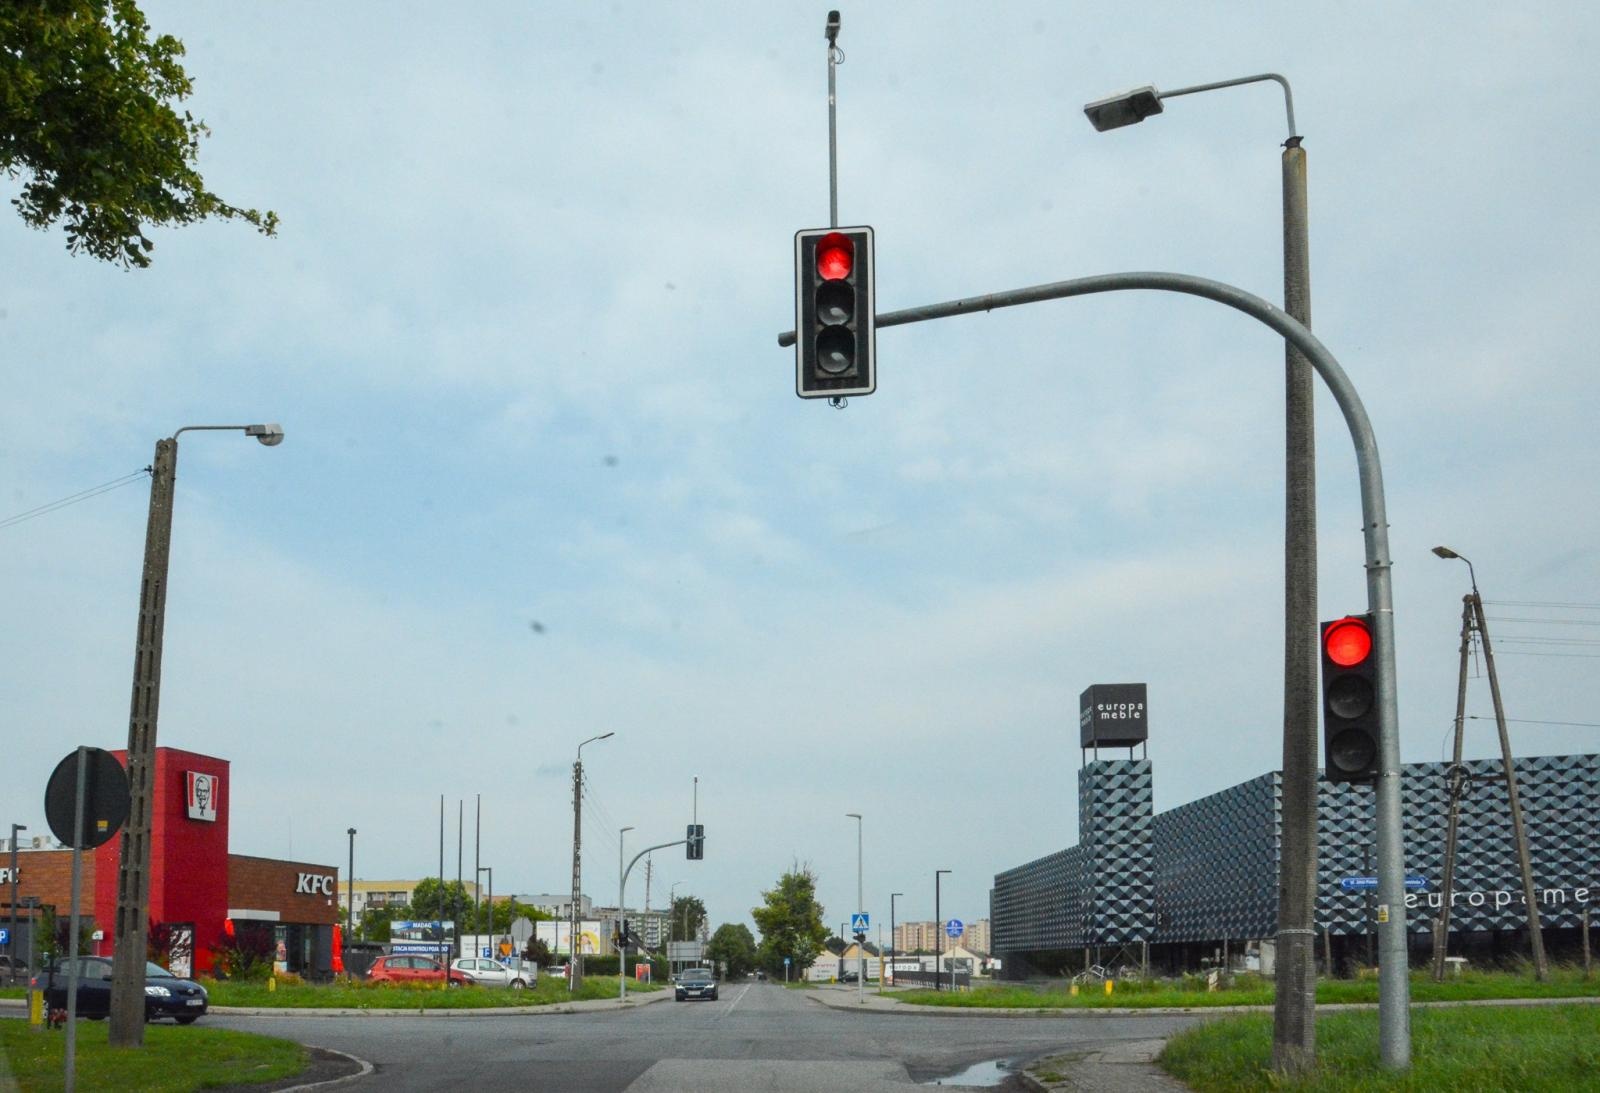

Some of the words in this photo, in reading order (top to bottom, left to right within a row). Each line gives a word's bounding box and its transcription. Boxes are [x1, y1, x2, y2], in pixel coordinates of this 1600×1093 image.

[1097, 703, 1143, 711] europa
[1101, 710, 1140, 719] meble
[296, 872, 334, 896] KFC
